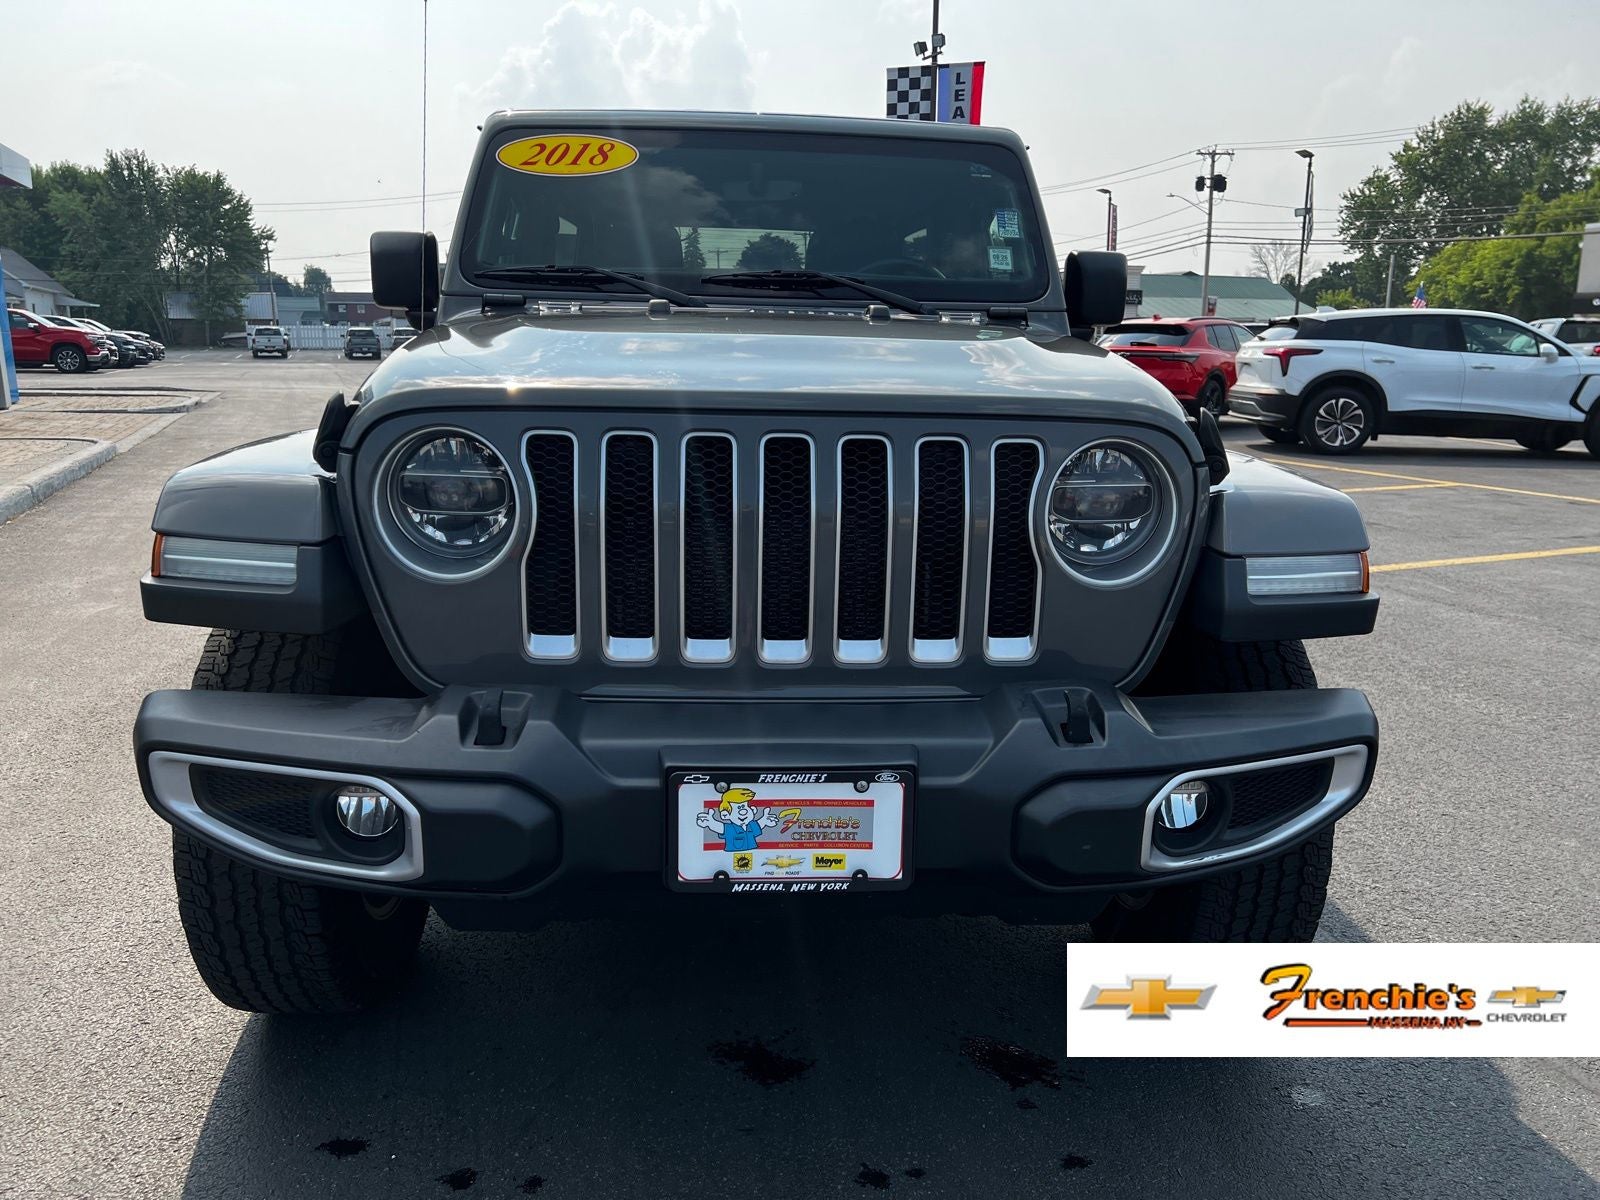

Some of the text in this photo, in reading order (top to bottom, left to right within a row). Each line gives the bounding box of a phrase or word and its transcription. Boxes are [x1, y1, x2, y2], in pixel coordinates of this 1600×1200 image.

[518, 142, 616, 166] 2018
[758, 773, 827, 783] FRENCHIE'S
[779, 807, 861, 834] Frenchie's
[791, 831, 858, 841] CHEVROLET
[815, 856, 843, 867] Meyer
[790, 883, 817, 892] NEW
[819, 882, 850, 892] YORK
